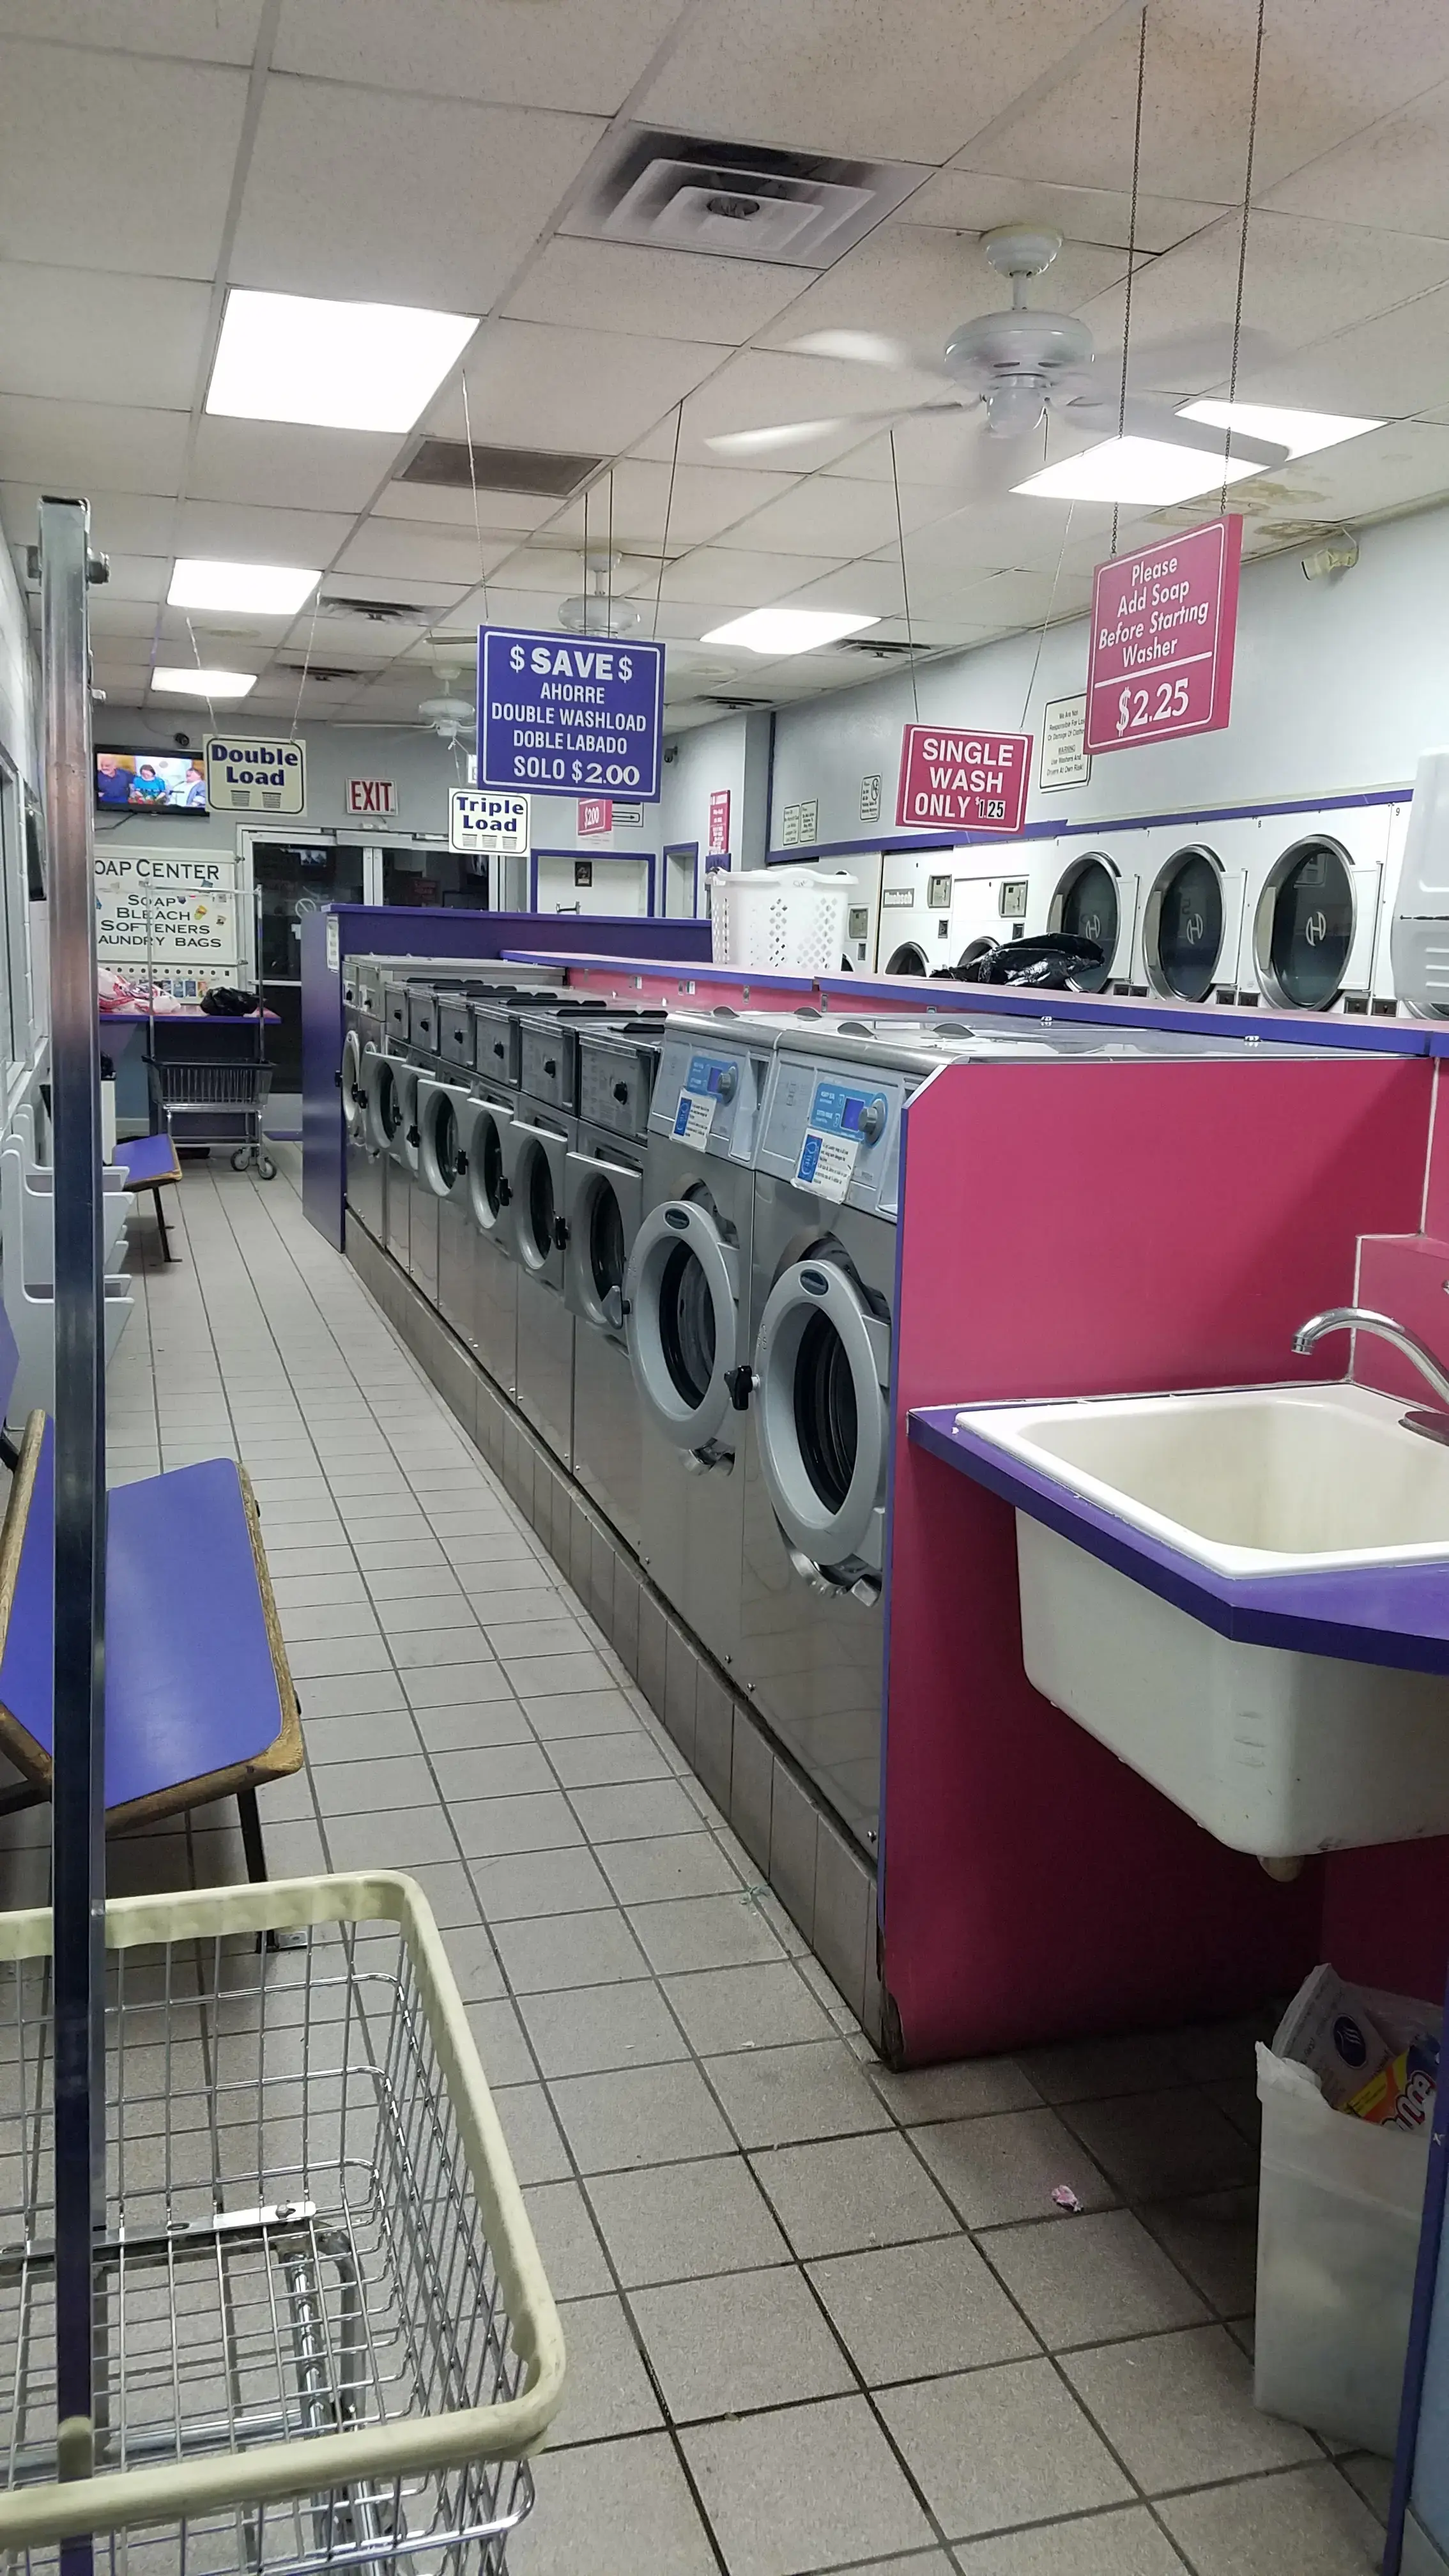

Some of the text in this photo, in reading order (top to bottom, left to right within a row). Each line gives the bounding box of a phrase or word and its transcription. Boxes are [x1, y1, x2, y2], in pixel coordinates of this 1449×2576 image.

[1131, 557, 1177, 586] Please
[1117, 581, 1190, 617] Add Soap
[1099, 602, 1209, 650] Before Starting
[531, 647, 613, 680] SAVE
[1123, 638, 1177, 668] Washer
[540, 682, 605, 704] AHORRE
[492, 703, 646, 732] DOUBLE WASHLOAD
[1116, 677, 1188, 737] $2.25
[211, 744, 298, 767] Double
[514, 730, 627, 755] DOBLE LABADO
[923, 739, 1013, 767] SINGLE
[226, 767, 285, 786] Load
[514, 756, 640, 786] SOLO $2.00
[930, 767, 1003, 793] WASH
[351, 781, 392, 811] EXIT
[456, 797, 524, 817] Triple
[916, 793, 971, 818] ONLY
[463, 814, 517, 832] Load
[95, 860, 132, 876] OAP
[98, 935, 222, 948] AUNDRY BAGS
